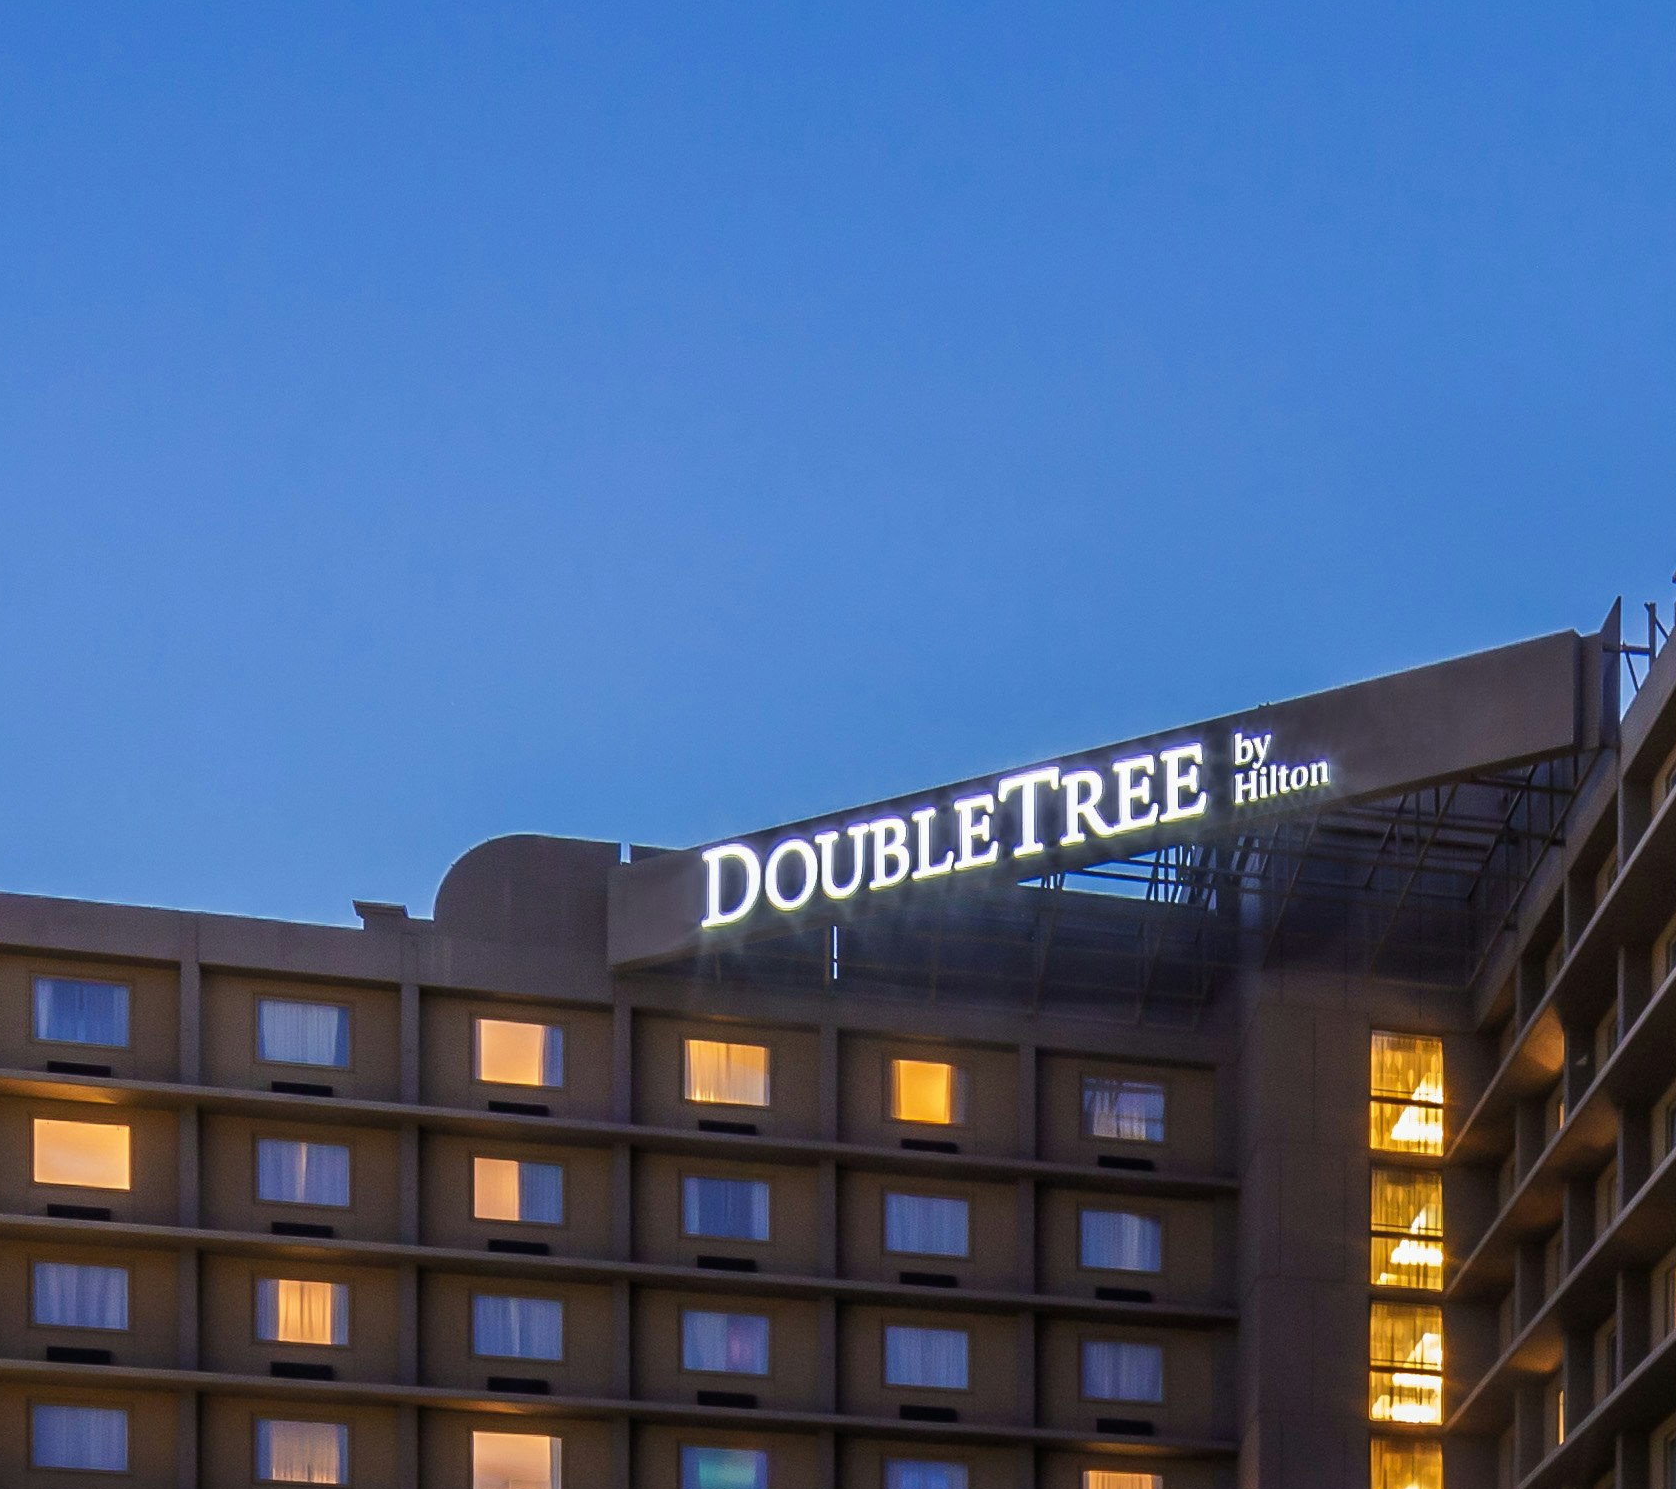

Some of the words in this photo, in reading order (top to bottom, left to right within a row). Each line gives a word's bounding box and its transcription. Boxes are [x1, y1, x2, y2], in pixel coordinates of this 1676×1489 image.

[1233, 732, 1272, 766] by
[700, 741, 1209, 929] DOUBLETREE
[1233, 758, 1330, 805] Hilton
